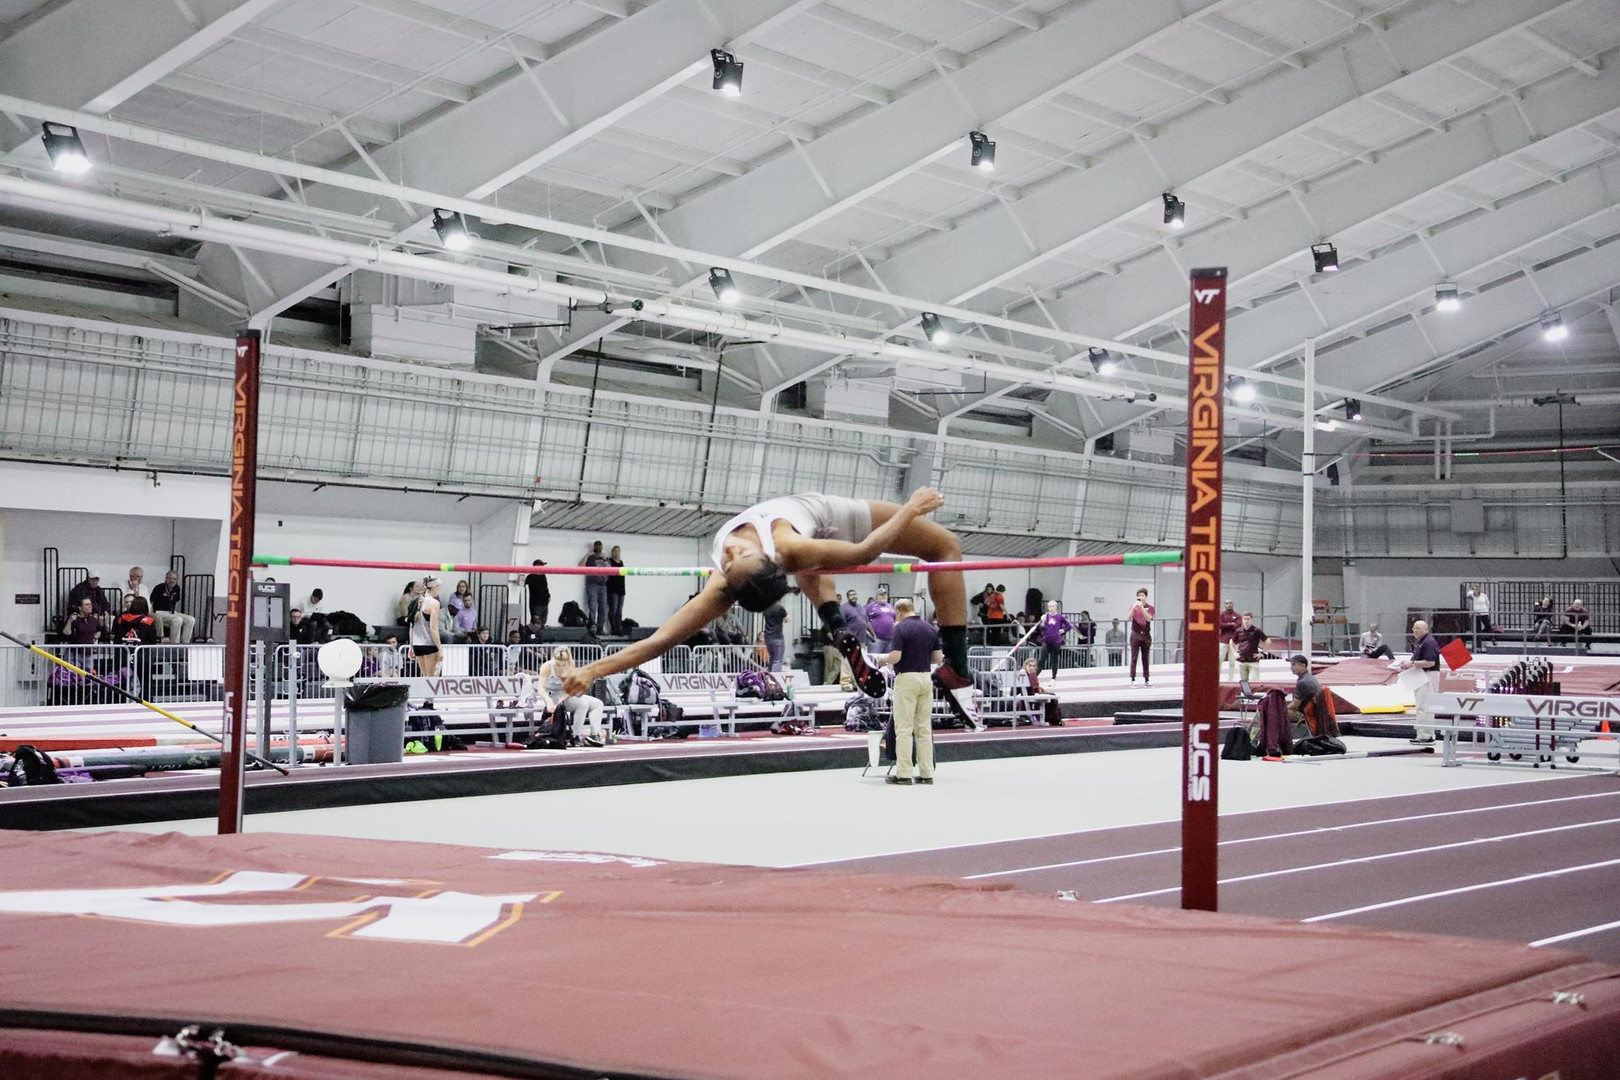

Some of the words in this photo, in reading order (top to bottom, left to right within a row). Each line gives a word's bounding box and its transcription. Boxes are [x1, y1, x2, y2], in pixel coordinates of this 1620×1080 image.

[1194, 289, 1220, 304] VT
[231, 372, 247, 522] VIRGINIA
[1191, 322, 1220, 513] VIRGINIA
[227, 527, 242, 618] TECH
[1188, 516, 1217, 632] TECH
[426, 679, 508, 695] VIRGINIA
[662, 675, 728, 690] VIRGINIA
[1456, 697, 1485, 711] VT
[1192, 723, 1211, 801] UCS
